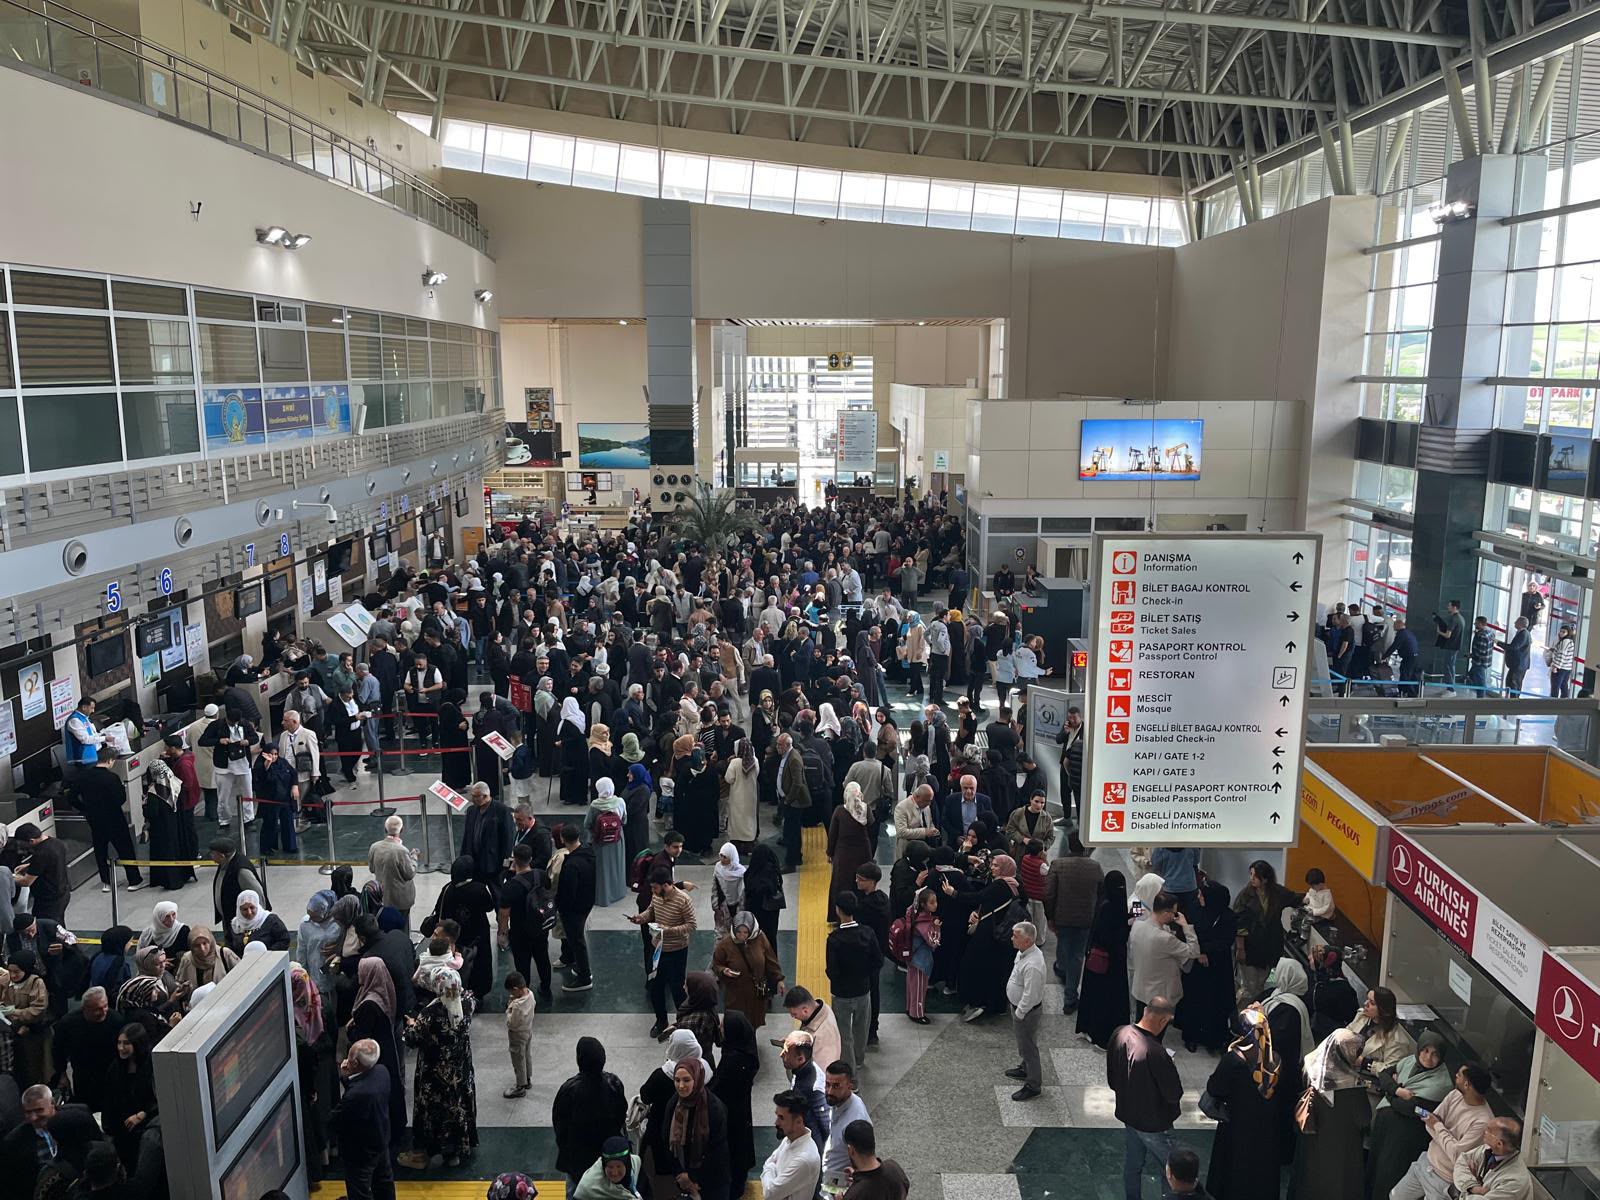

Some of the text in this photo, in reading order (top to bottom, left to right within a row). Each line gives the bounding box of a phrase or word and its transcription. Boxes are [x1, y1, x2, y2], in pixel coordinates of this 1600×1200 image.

[280, 532, 289, 556] 8
[246, 544, 255, 566] 7
[1144, 554, 1191, 563] DANIŞMA
[160, 568, 172, 595] 6
[1142, 582, 1250, 593] BİLET BAGAJ KONTROL
[106, 582, 121, 612] 5
[1142, 597, 1183, 605] Check-in
[1141, 613, 1202, 624] BİLET SATIŞ
[1141, 626, 1196, 635] Ticket Sales
[1139, 643, 1246, 651] PASAPORT KONTROL
[1139, 653, 1181, 661] Passport
[1139, 671, 1195, 679] RESTORAN
[1137, 694, 1172, 702] MESCİT
[1137, 705, 1172, 713] Mosque
[1136, 723, 1169, 732] ENGELLİ
[1171, 723, 1193, 732] BİLET
[1224, 724, 1261, 732] KONTROL
[1135, 734, 1173, 743] Disabled
[1133, 783, 1172, 792] ENGELLİ
[1132, 794, 1170, 802] Disabled
[1172, 795, 1212, 803] Passport
[1132, 810, 1216, 820] ENGELLİ DANIŞMA
[1326, 810, 1360, 846] PEGASUS
[1417, 861, 1470, 918] TURKISH
[1414, 881, 1468, 938] AIRLINES
[1491, 926, 1525, 958] REZERVASYON
